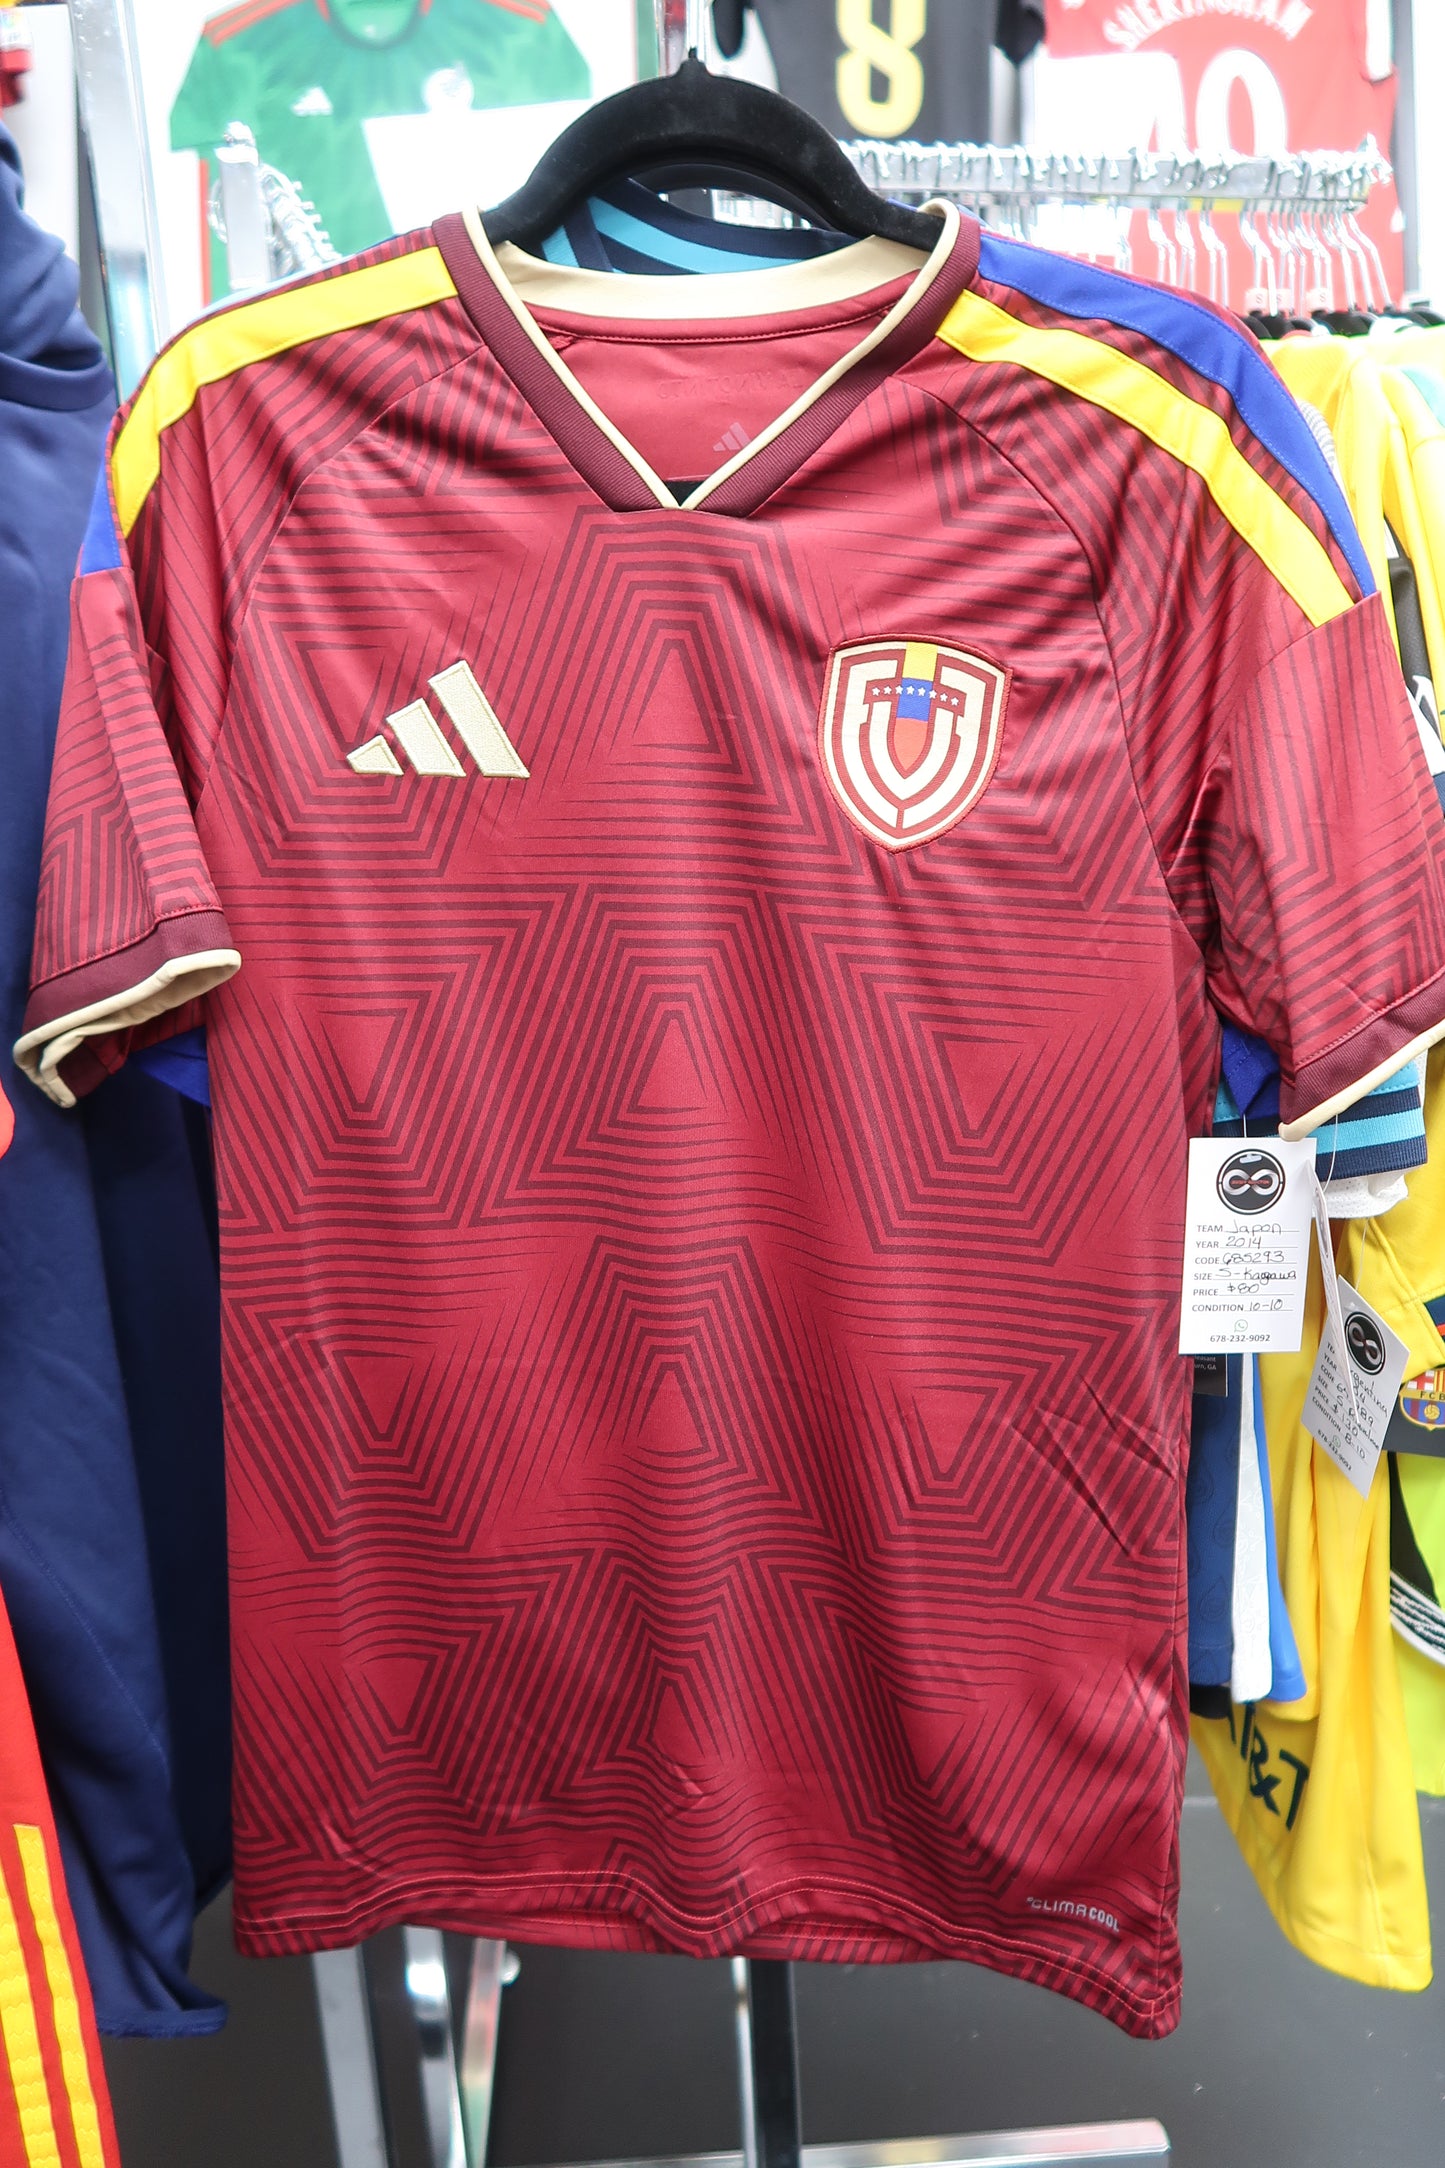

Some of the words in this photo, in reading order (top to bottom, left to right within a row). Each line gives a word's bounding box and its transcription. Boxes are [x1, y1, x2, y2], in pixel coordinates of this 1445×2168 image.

[1197, 1225, 1223, 1233] TEAM
[1195, 1240, 1219, 1249] YEAR
[1225, 1236, 1262, 1250] 2014
[1194, 1257, 1220, 1265] CODE
[1193, 1273, 1213, 1281] SIZE
[1193, 1288, 1219, 1296] PRICE
[1227, 1282, 1260, 1295] $80
[1191, 1304, 1244, 1312] CONDITION
[1209, 1333, 1271, 1343] 678-232-9092
